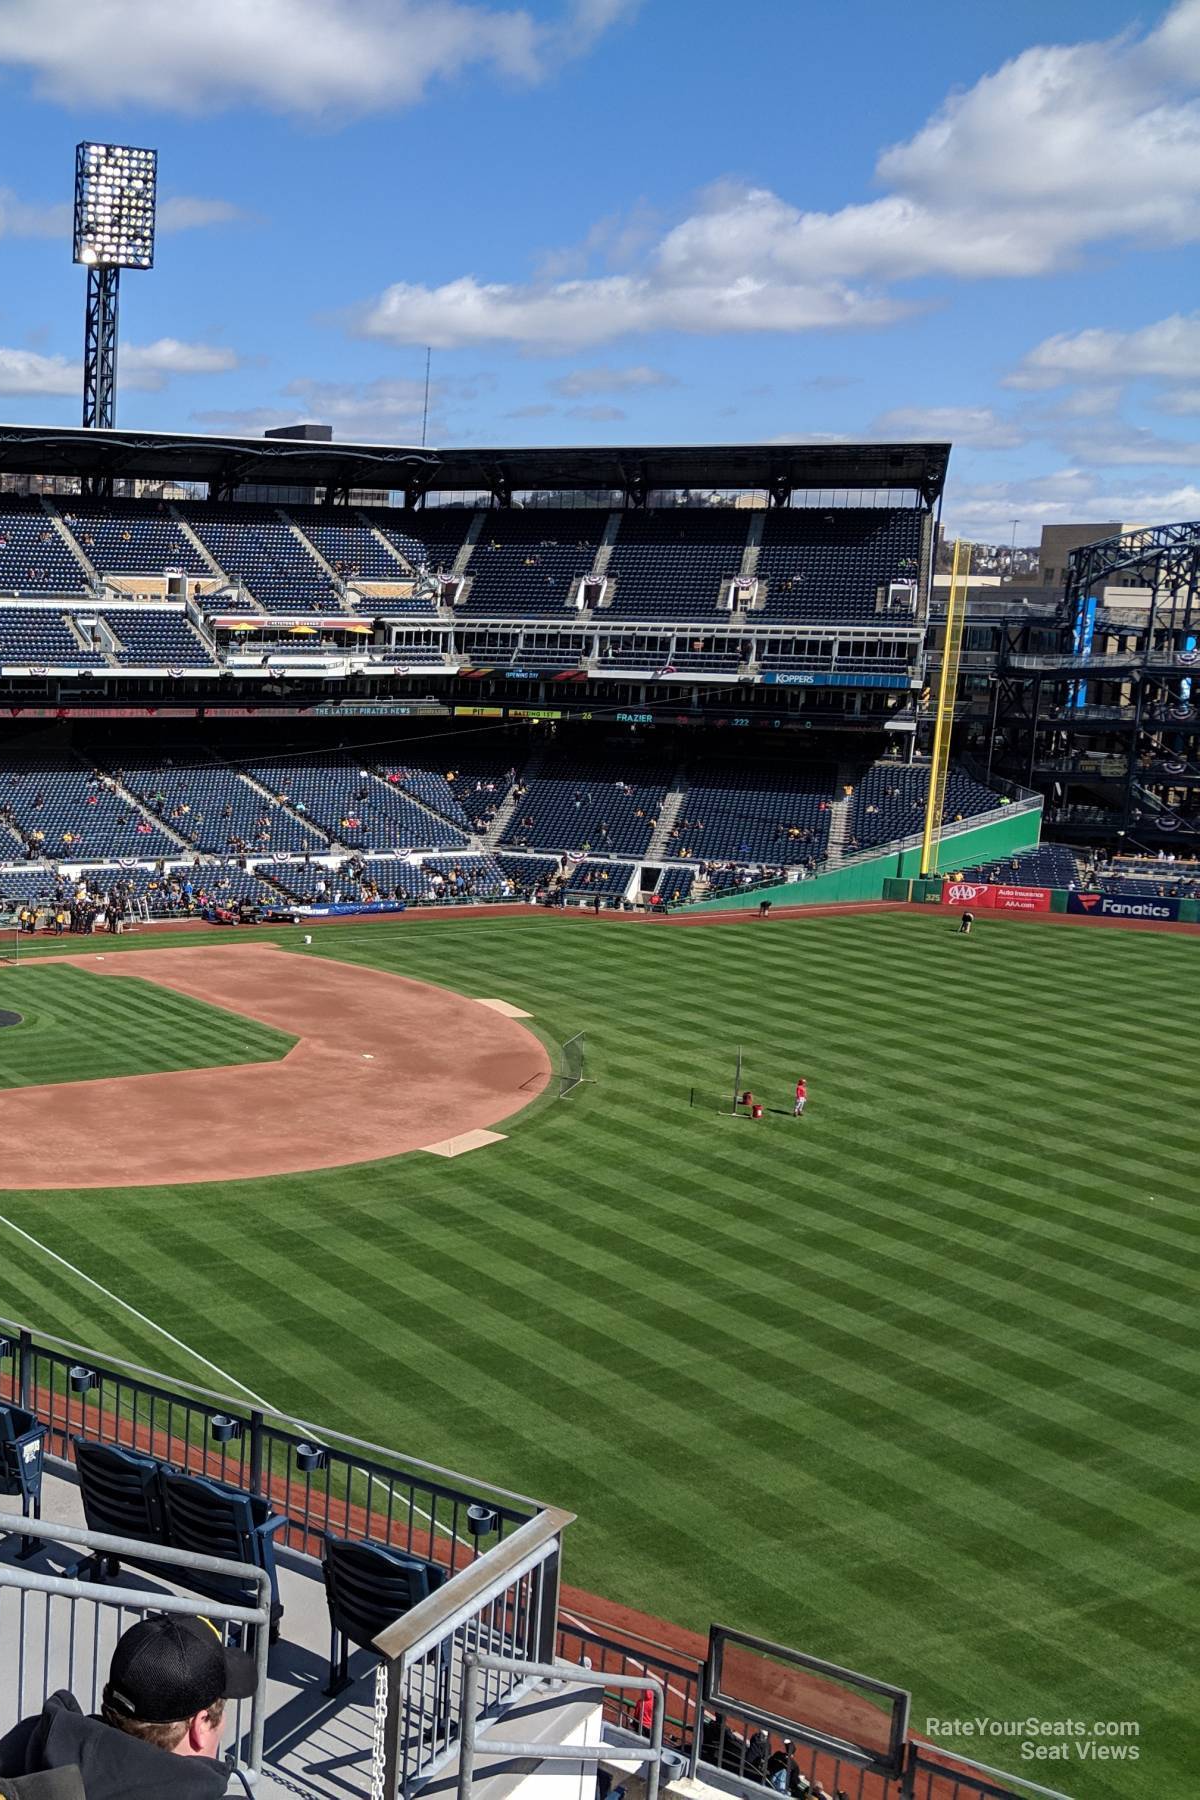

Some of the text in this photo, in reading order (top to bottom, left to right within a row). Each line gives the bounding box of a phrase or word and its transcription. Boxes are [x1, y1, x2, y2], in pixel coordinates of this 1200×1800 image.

[775, 673, 815, 684] KOPPERS
[315, 707, 329, 715] THE
[331, 707, 357, 715] LATEST
[359, 707, 388, 715] PIRATES
[472, 708, 485, 716] PIT
[581, 711, 593, 720] 26
[616, 713, 653, 723] FRAZIER
[998, 889, 1044, 898] Auto Insurance
[1005, 901, 1035, 909] AAA.com
[1102, 899, 1170, 918] Fanatics
